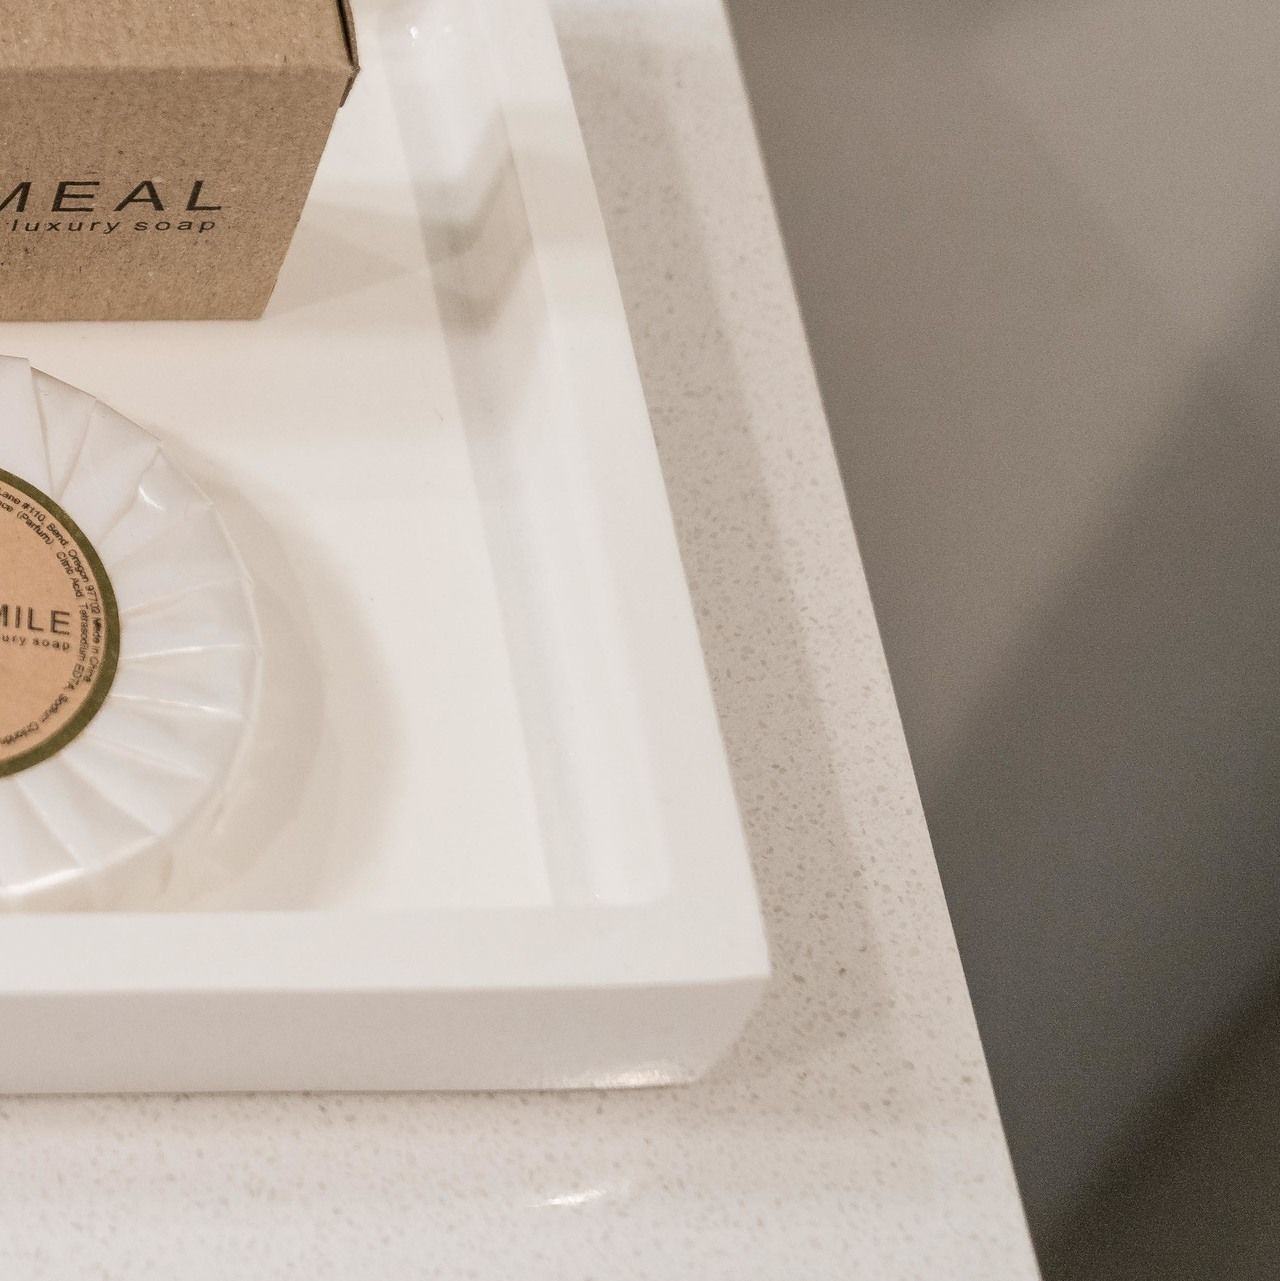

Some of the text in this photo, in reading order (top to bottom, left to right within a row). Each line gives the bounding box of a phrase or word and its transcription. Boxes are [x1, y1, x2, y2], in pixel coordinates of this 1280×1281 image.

[11, 218, 121, 235] luxury
[133, 220, 216, 234] soap
[21, 502, 47, 523] #110,
[56, 551, 74, 576] Citric
[67, 549, 90, 583] Oregon
[84, 584, 101, 615] 97702
[92, 617, 102, 644] Made
[32, 638, 71, 652] soap
